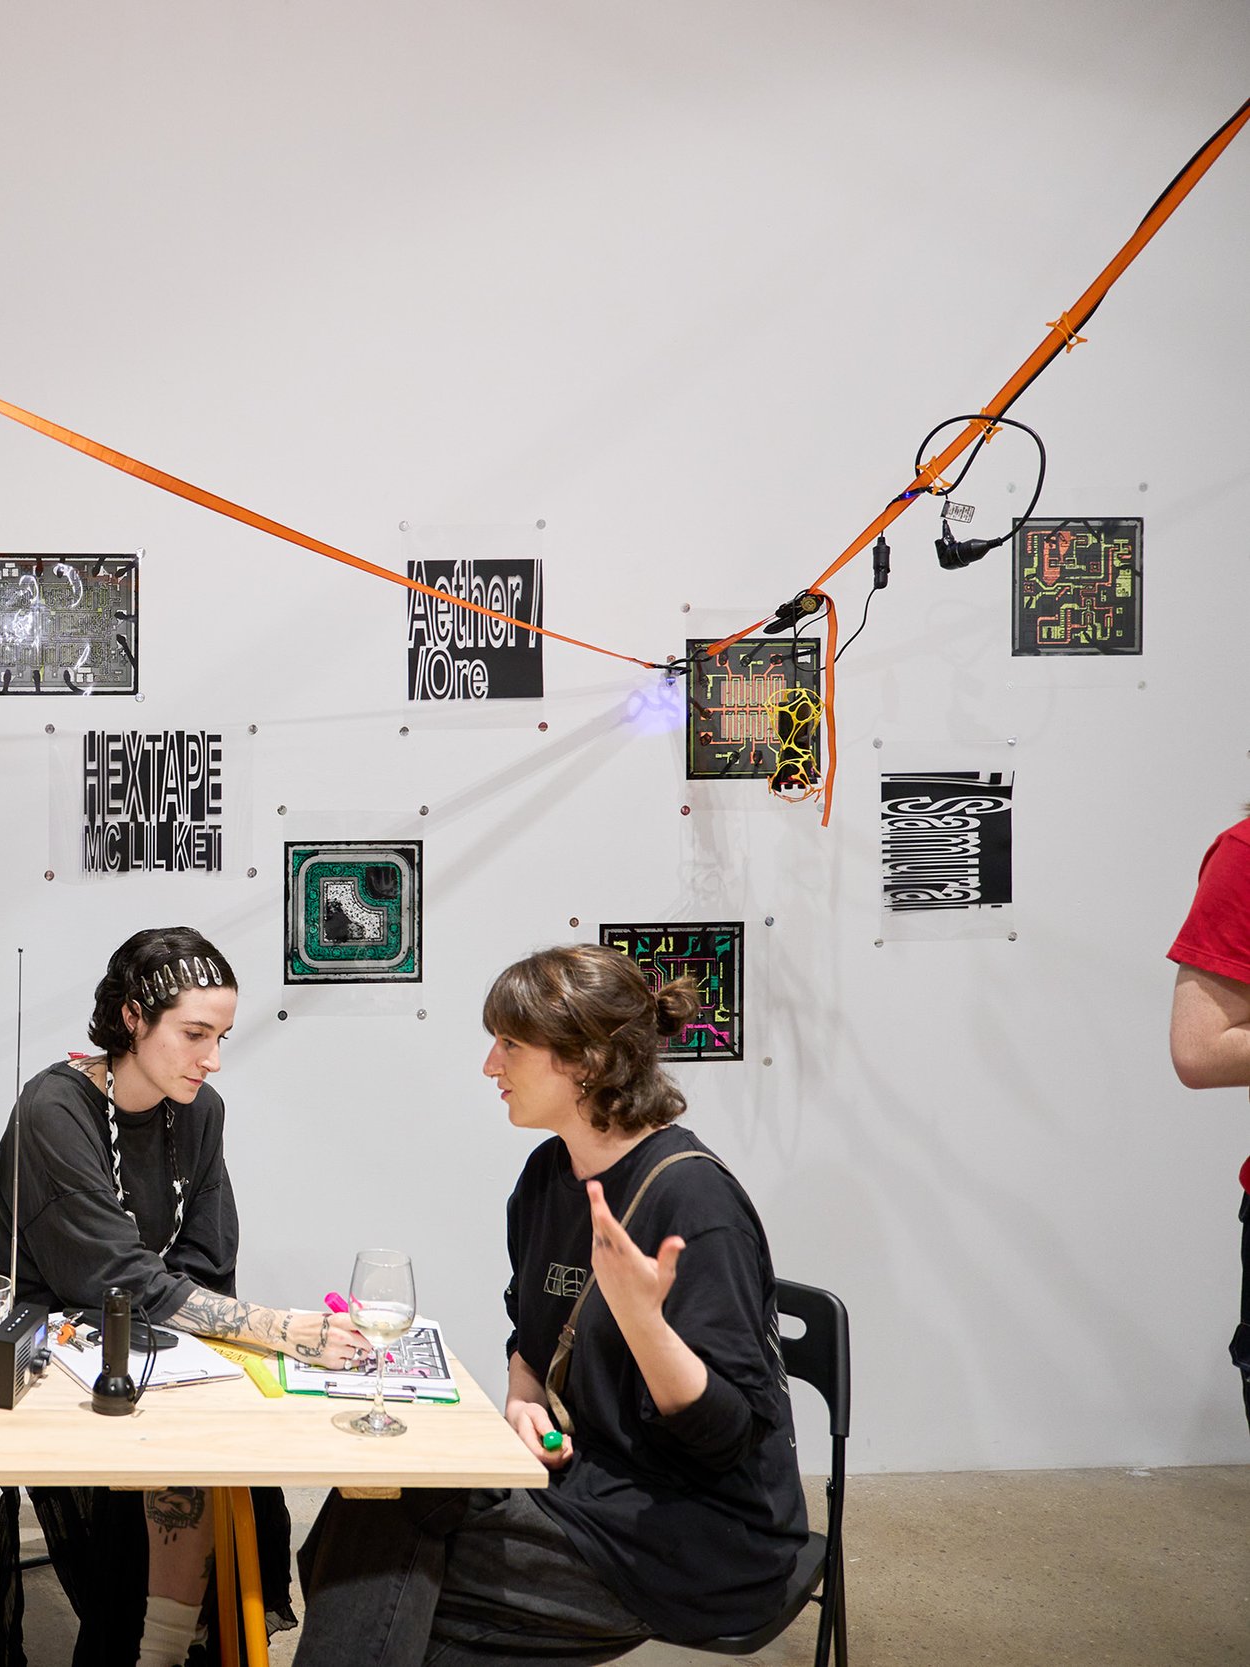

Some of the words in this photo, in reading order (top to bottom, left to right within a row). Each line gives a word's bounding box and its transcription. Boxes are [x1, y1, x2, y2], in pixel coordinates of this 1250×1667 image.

[408, 560, 523, 649] Aether
[83, 731, 222, 822] HEXTAPE
[83, 822, 122, 872] MC
[881, 795, 1012, 911] Samurai
